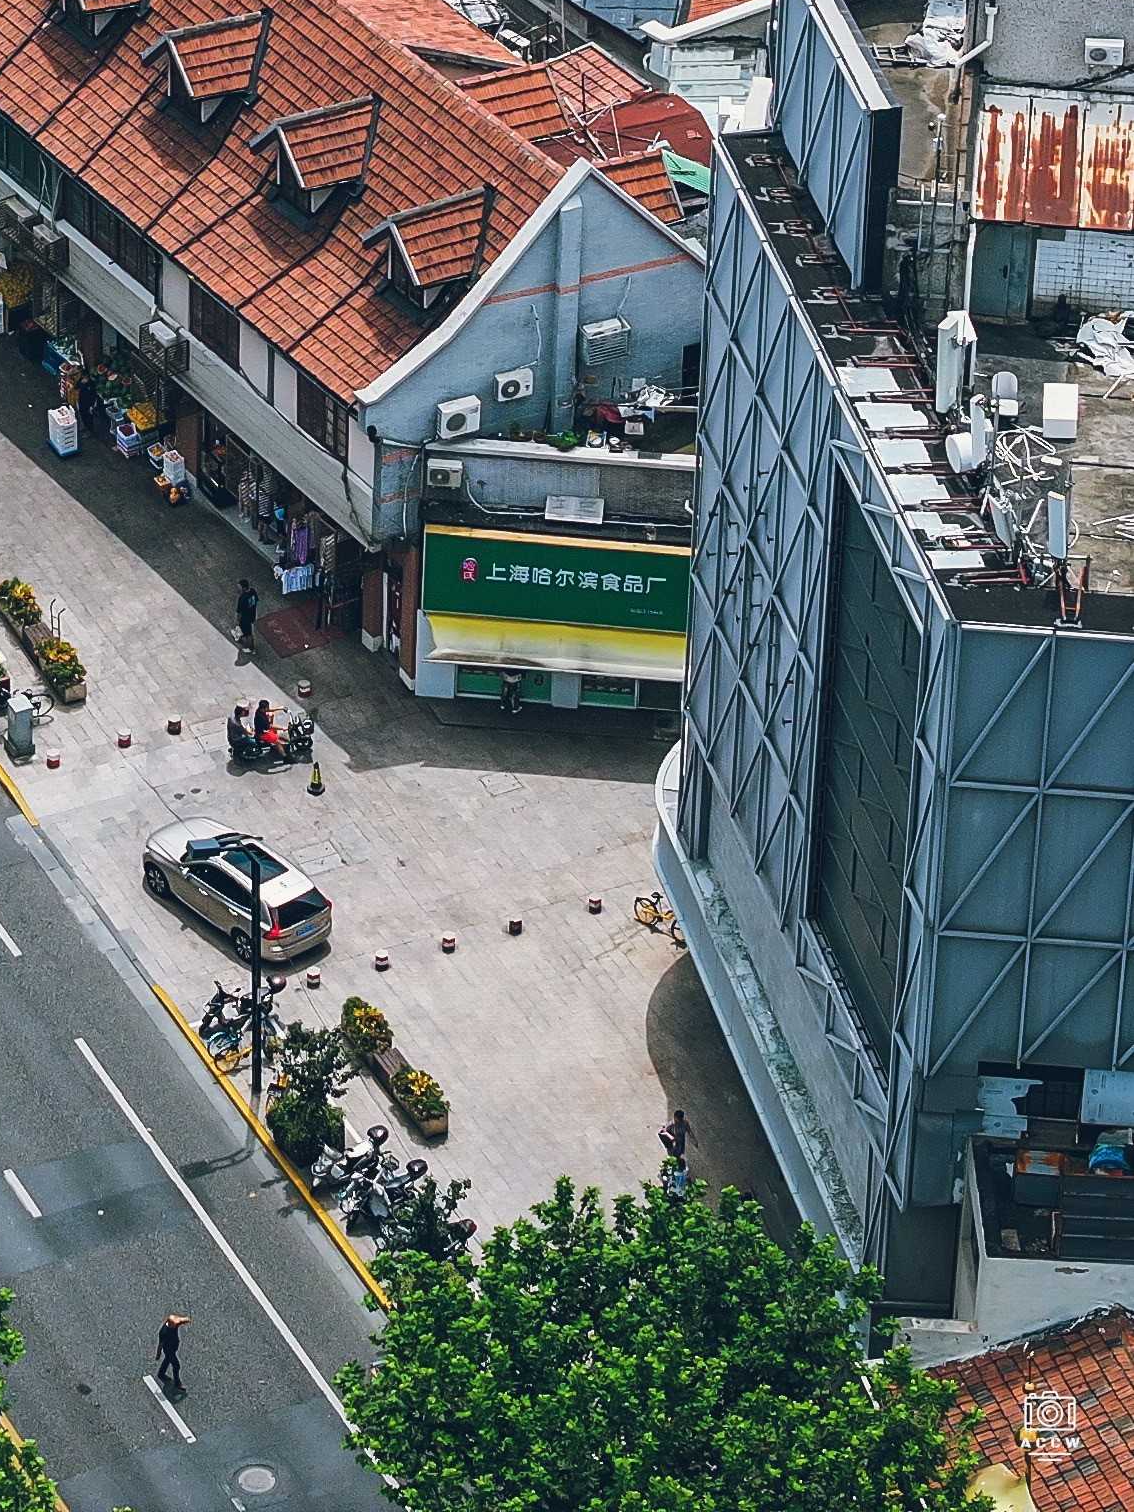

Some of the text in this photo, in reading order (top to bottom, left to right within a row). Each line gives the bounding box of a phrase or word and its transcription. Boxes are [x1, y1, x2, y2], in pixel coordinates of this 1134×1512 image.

[485, 562, 667, 594] 上海哈尔滨食品厂
